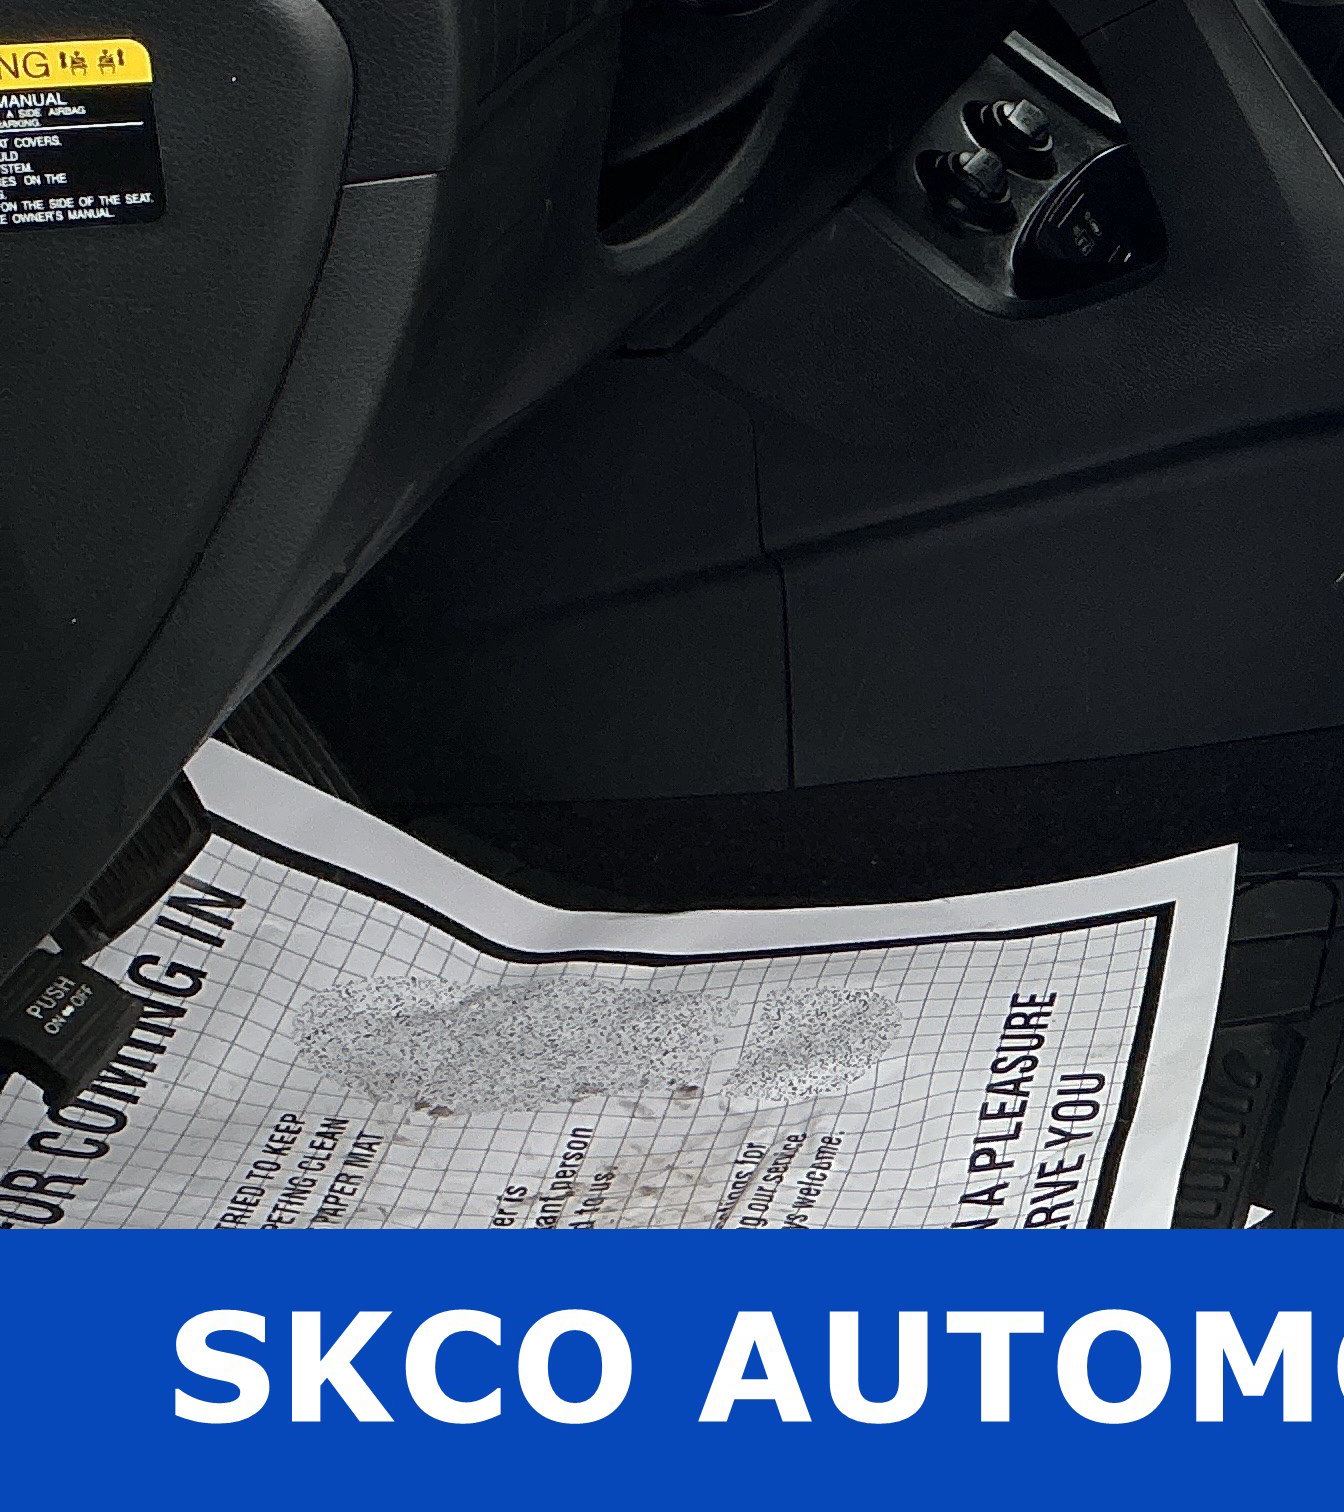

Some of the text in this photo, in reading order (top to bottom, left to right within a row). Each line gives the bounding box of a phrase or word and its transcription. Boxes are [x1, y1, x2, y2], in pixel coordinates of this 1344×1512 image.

[21, 200, 45, 211] THE
[50, 198, 74, 209] SIDE
[79, 195, 94, 207] OF
[99, 194, 121, 205] THE
[24, 175, 41, 186] ON
[45, 173, 68, 184] THE
[25, 974, 74, 1018] PUSH
[44, 981, 94, 1033] ON OFF
[0, 1168, 88, 1228] OR
[156, 874, 247, 947] IN
[966, 991, 1057, 1172] PLEASURE
[256, 1112, 305, 1155] KEEP
[297, 1115, 351, 1171] CLEAN
[549, 1126, 593, 1189] person
[733, 1141, 767, 1165] for
[1022, 1072, 1105, 1228] RVE YOU
[246, 1160, 281, 1179] TO
[311, 1130, 384, 1223] PAPER MAT
[747, 1185, 777, 1211] our
[762, 1131, 807, 1182] service
[791, 1130, 845, 1207] welcome.
[957, 1180, 1010, 1205] A
[496, 1185, 527, 1201] is
[573, 1196, 604, 1214] to
